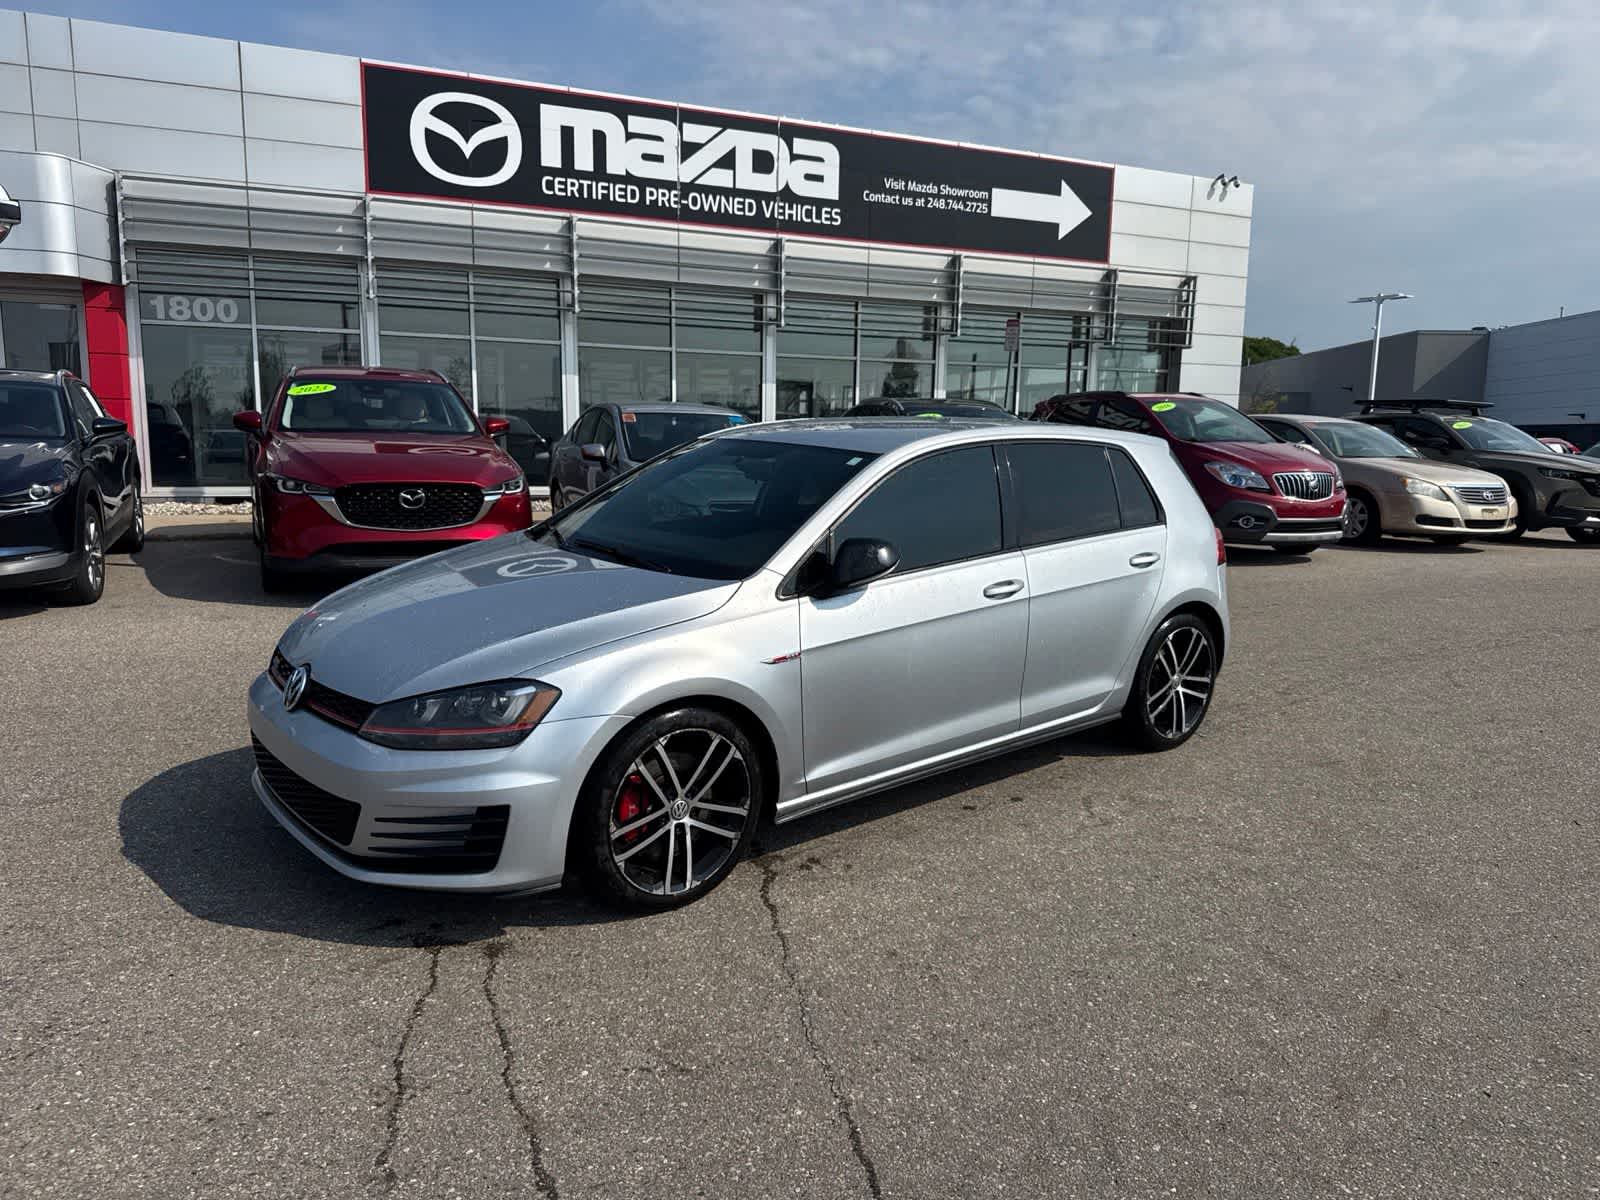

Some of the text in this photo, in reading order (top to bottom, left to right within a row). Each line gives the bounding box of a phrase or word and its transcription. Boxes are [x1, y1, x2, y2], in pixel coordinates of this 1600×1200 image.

[541, 175, 842, 225] CERTIFIED PRE-OWNED VEHICLES
[884, 177, 989, 199] Visit Mazda Showroom
[863, 190, 989, 214] Contact us at 248.744.2725
[150, 295, 239, 323] 1800
